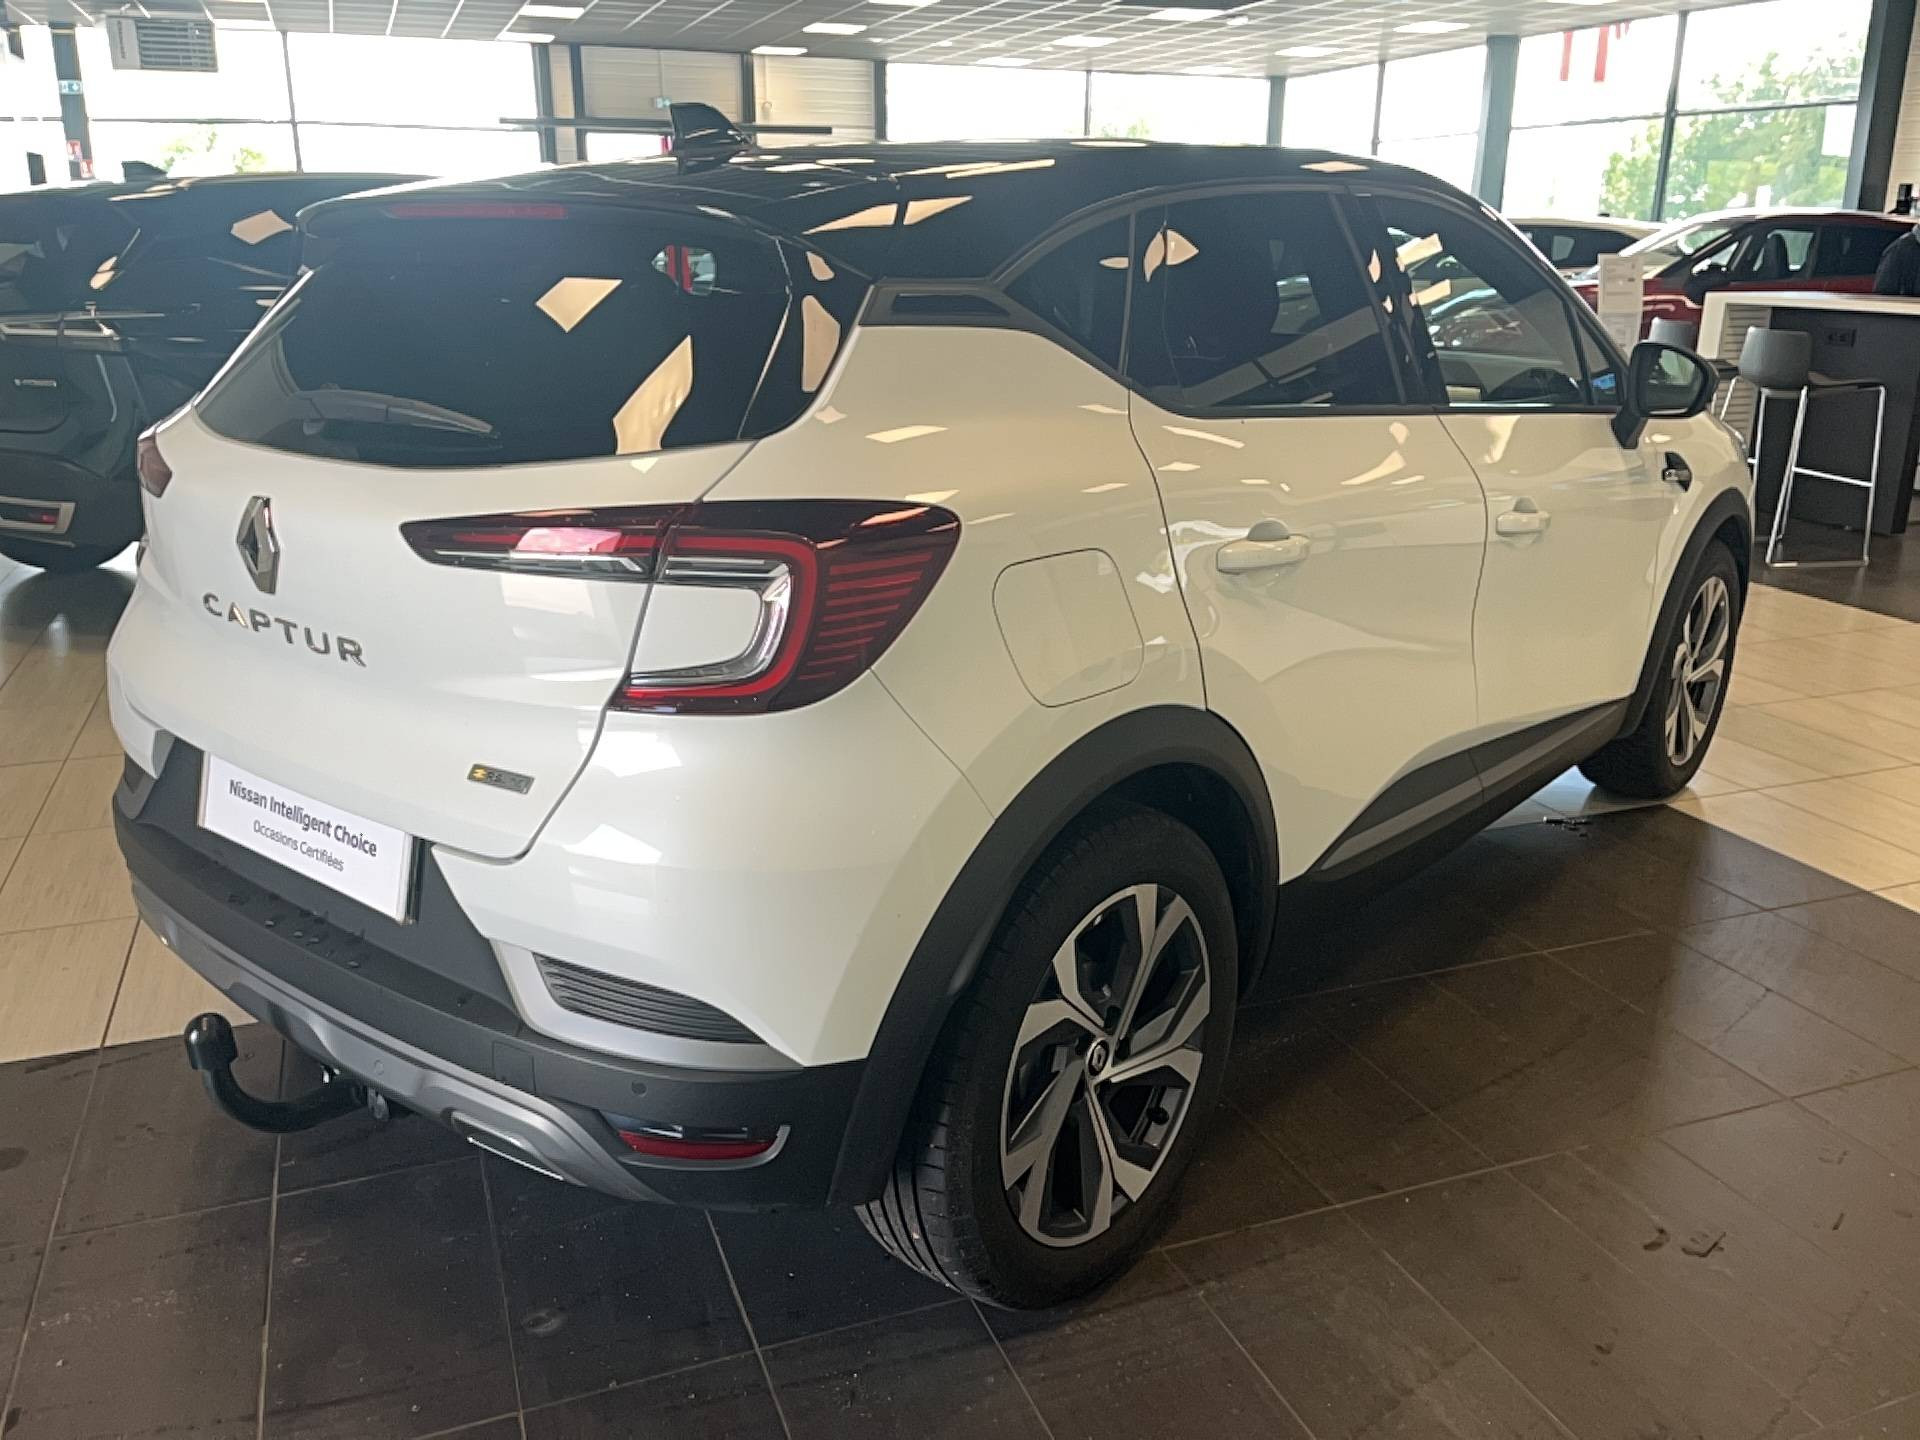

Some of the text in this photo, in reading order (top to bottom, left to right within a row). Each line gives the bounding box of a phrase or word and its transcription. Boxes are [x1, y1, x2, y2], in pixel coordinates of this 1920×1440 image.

[203, 592, 367, 667] CAPTUR
[229, 779, 377, 857] Nissan Intelligent Choice
[253, 819, 344, 872] Occasions Certifiées
